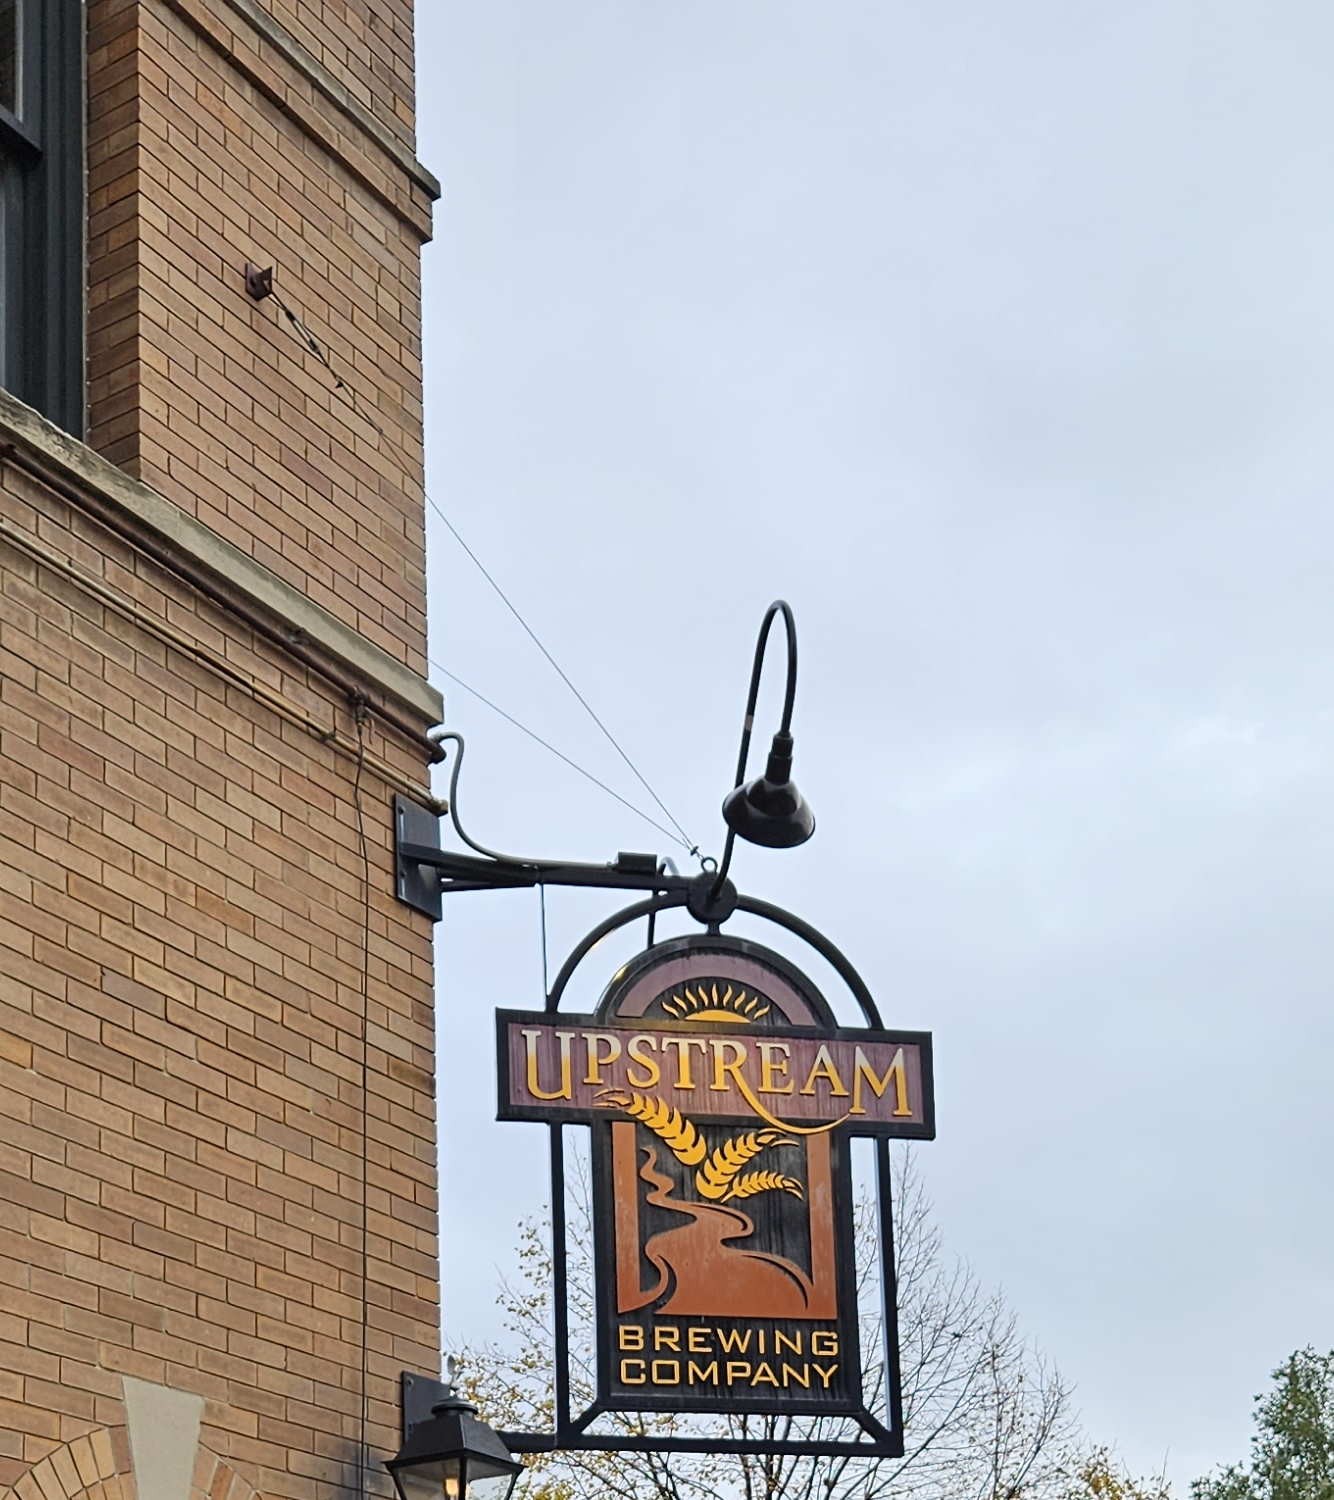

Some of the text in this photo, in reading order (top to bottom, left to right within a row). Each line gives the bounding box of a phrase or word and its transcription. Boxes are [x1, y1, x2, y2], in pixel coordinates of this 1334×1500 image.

[520, 1028, 913, 1134] UPSTREAM
[619, 1324, 839, 1356] BREWING
[620, 1359, 839, 1388] COMPANY
